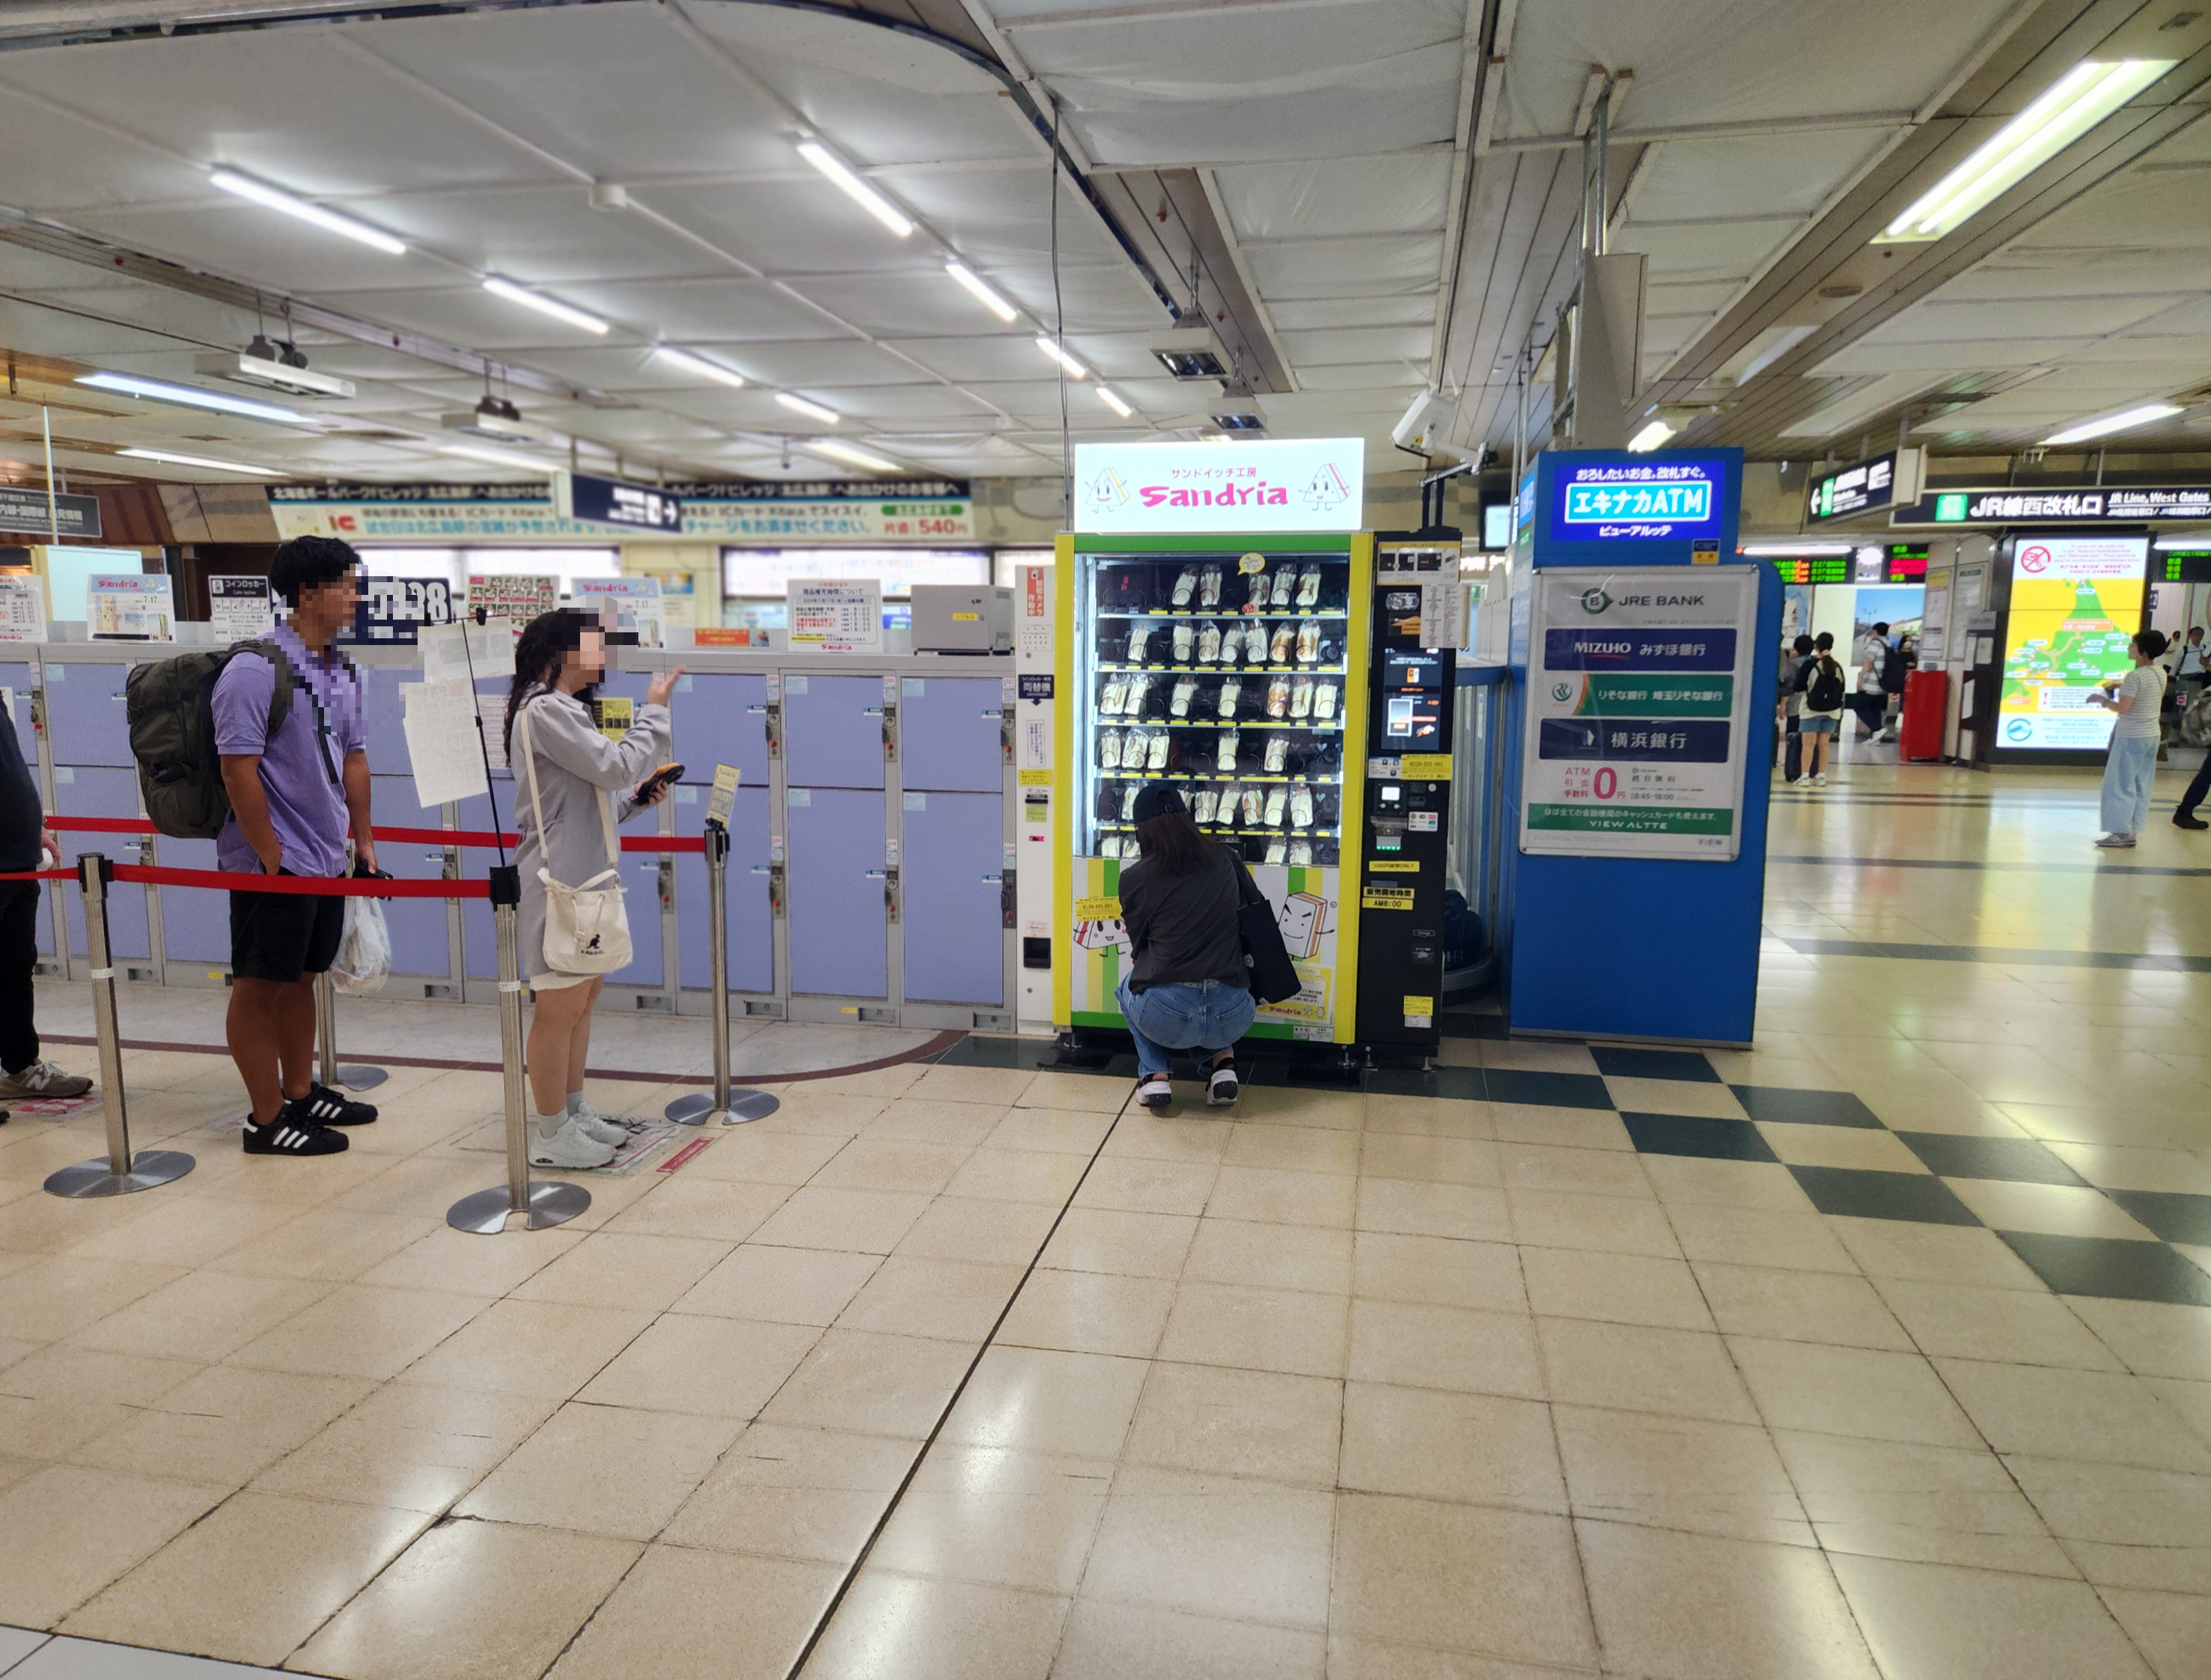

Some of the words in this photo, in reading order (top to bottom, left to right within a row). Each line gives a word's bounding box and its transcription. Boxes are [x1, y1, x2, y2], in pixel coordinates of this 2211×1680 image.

[1171, 467, 1257, 479] サンドイッチ工房
[1139, 480, 1288, 507] Sandria
[2108, 492, 2123, 504] JR
[2150, 492, 2177, 503] West
[2179, 491, 2210, 503] Gates
[1573, 488, 1704, 514] エキナカATM
[1970, 495, 2103, 516] JR線西改札口
[1599, 525, 1673, 537] ビューアルッテ
[97, 580, 138, 588] Sandria
[225, 580, 266, 588] コインロッカー
[583, 584, 628, 592] Sandria
[1619, 596, 1650, 606] JRE
[1656, 596, 1704, 606] BANK
[1573, 642, 1632, 654] MIZUHO
[1639, 644, 1707, 656] みずほ銀行
[1023, 682, 1051, 692] 両替機
[1598, 690, 1647, 701] りそな銀行
[1652, 690, 1724, 702] 埼玉りそな銀行
[1611, 732, 1688, 749] 横浜銀行
[1565, 767, 1591, 776] ATM
[1564, 778, 1589, 787] 引出
[1594, 767, 1617, 799] 0
[1617, 791, 1626, 799] 円
[1564, 789, 1588, 798] 手数料
[1626, 822, 1668, 830] ALTTE
[1367, 888, 1412, 896] 販売開始時間
[1269, 1006, 1301, 1015] Sandria
